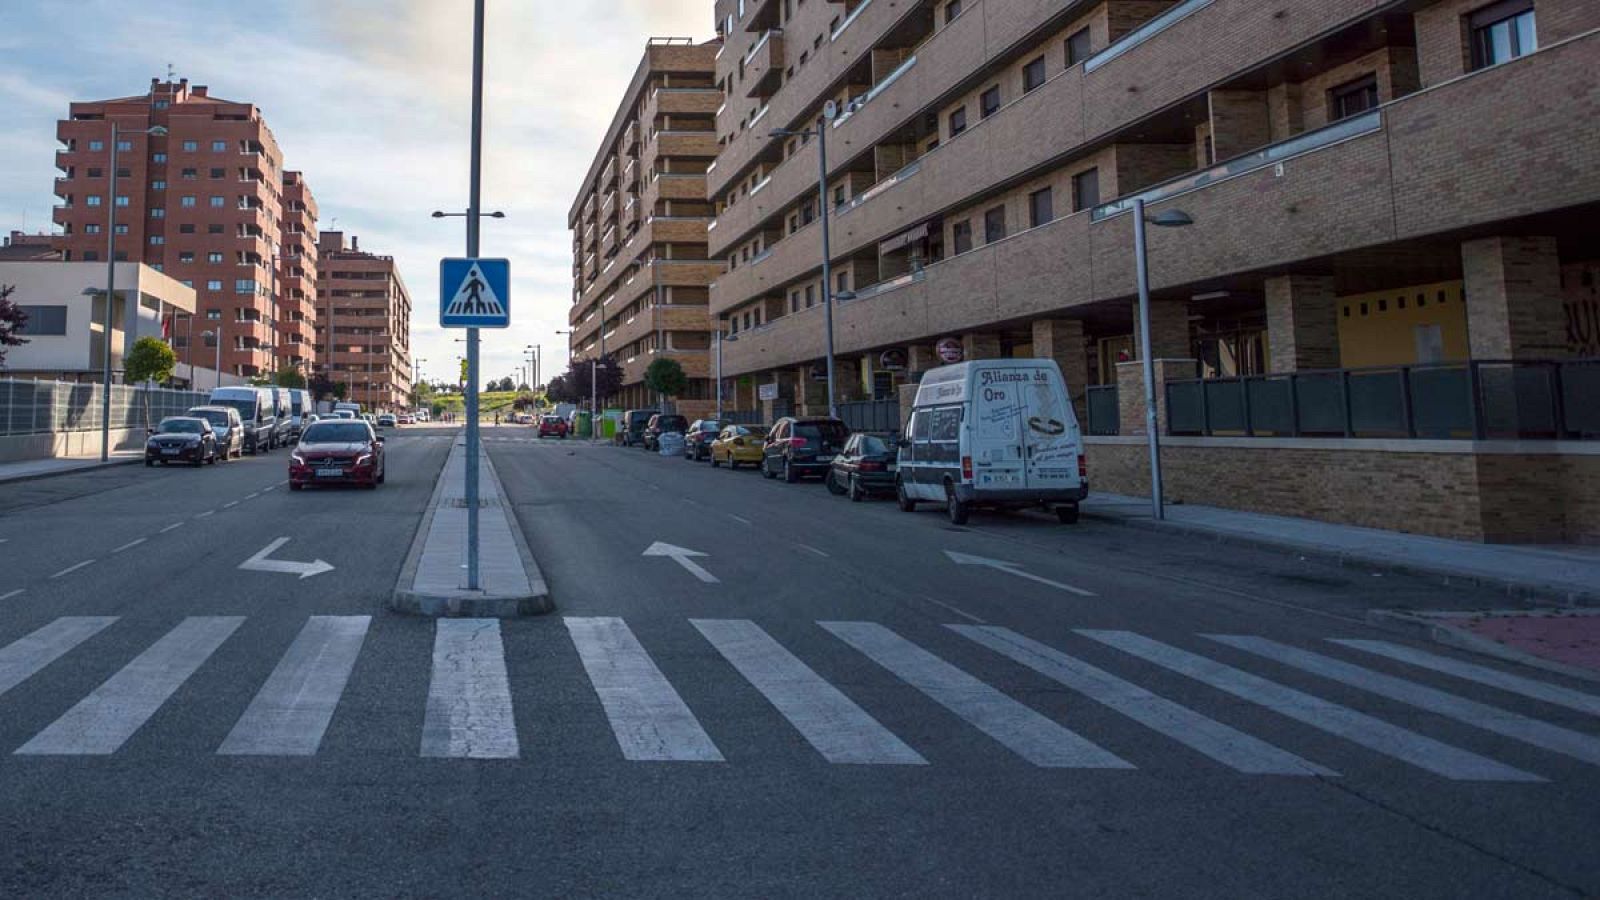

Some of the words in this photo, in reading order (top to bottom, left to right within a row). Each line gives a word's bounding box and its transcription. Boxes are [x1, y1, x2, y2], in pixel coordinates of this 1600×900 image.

[981, 371, 1029, 385] Alianza
[1033, 369, 1048, 381] de
[984, 387, 1005, 402] Oro
